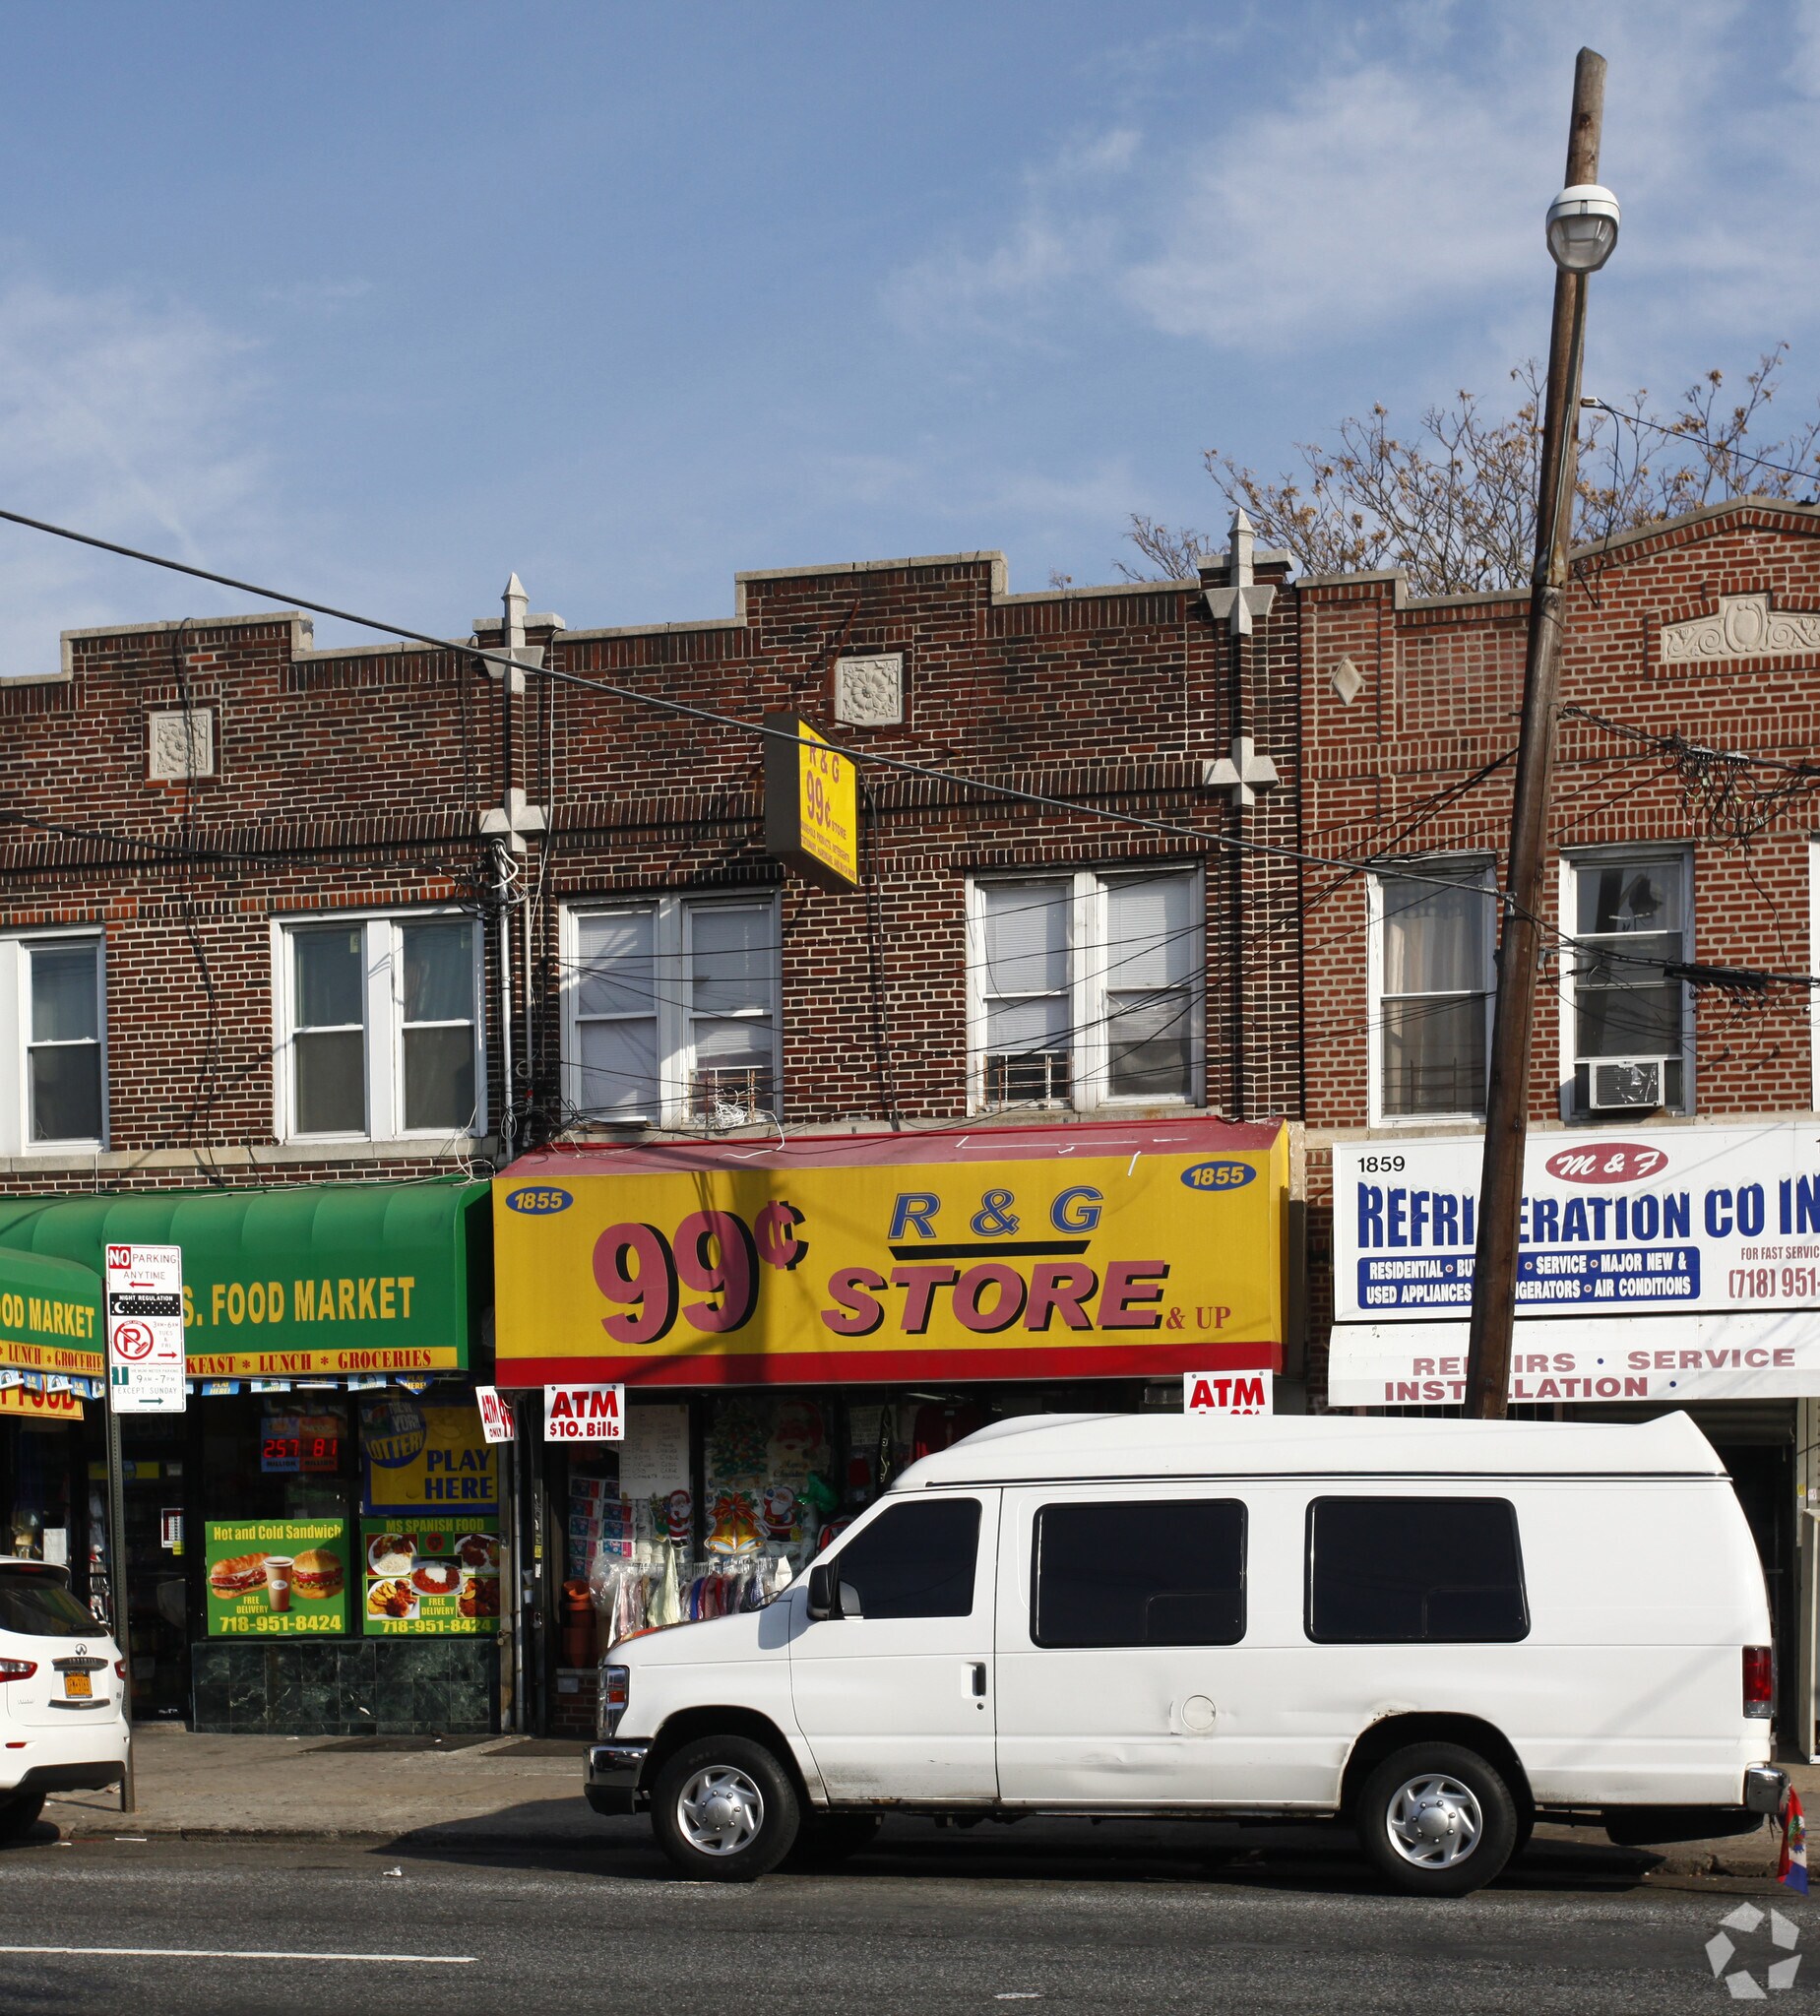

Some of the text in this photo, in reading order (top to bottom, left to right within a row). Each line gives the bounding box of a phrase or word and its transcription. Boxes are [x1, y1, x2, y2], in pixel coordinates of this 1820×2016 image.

[831, 754, 840, 784] G
[1357, 1156, 1406, 1173] 1859
[1556, 1151, 1661, 1175] M & F
[1191, 1166, 1245, 1186] 1855
[515, 1192, 563, 1210] 1855
[888, 1185, 1104, 1240] R & G
[1357, 1180, 1691, 1248] REFRIERATION
[1705, 1181, 1765, 1238] CO
[109, 1249, 177, 1266] NO PARKING
[1740, 1247, 1758, 1261] FOR
[1761, 1246, 1784, 1260] FAST
[124, 1271, 165, 1280] ANYTIME
[593, 1200, 809, 1345] 99¢
[1369, 1260, 1443, 1280] RESIDENTIAL
[1536, 1255, 1587, 1275] SERVICE
[1600, 1253, 1642, 1272] MAJOR
[1646, 1252, 1673, 1271] NEW
[1677, 1251, 1687, 1270] &
[1366, 1286, 1398, 1304] USED
[1401, 1283, 1473, 1303] APPLIANCES
[1595, 1279, 1614, 1297] AIR
[1618, 1276, 1691, 1296] CONDITIONS
[1728, 1268, 1776, 1299] (718)
[213, 1282, 285, 1325] FOOD
[295, 1277, 415, 1321] MARKET
[821, 1260, 1170, 1337] STORE
[0, 1293, 94, 1339] OD MARKET
[1165, 1305, 1231, 1330] & UP
[8, 1345, 41, 1364] LUNCH
[186, 1349, 431, 1374] KFAST LUNCH GROCERIES
[1413, 1348, 1795, 1376] REIRS SERVICE
[1189, 1378, 1266, 1408] ATM
[1385, 1376, 1648, 1402] INSTLATION
[388, 1402, 412, 1415] NEW
[481, 1395, 500, 1424] ATM
[549, 1390, 619, 1418] ATM
[392, 1414, 421, 1433] YORK
[488, 1427, 502, 1438] ONLY
[549, 1421, 620, 1437] $10. Bills
[264, 1438, 338, 1458] 257 81
[365, 1428, 423, 1460] LOTTERY
[427, 1449, 490, 1473] PLAY
[425, 1477, 492, 1500] HERE
[214, 1524, 342, 1541] Hot and Cold Sandwich
[386, 1518, 485, 1533] MS SPANISH FOOD
[236, 1606, 268, 1614] DELIVERY
[421, 1606, 455, 1615] DELIVERY
[428, 1597, 445, 1606] FREE
[220, 1615, 342, 1632] 718-951-8424
[382, 1619, 492, 1632] 718-951-8424
